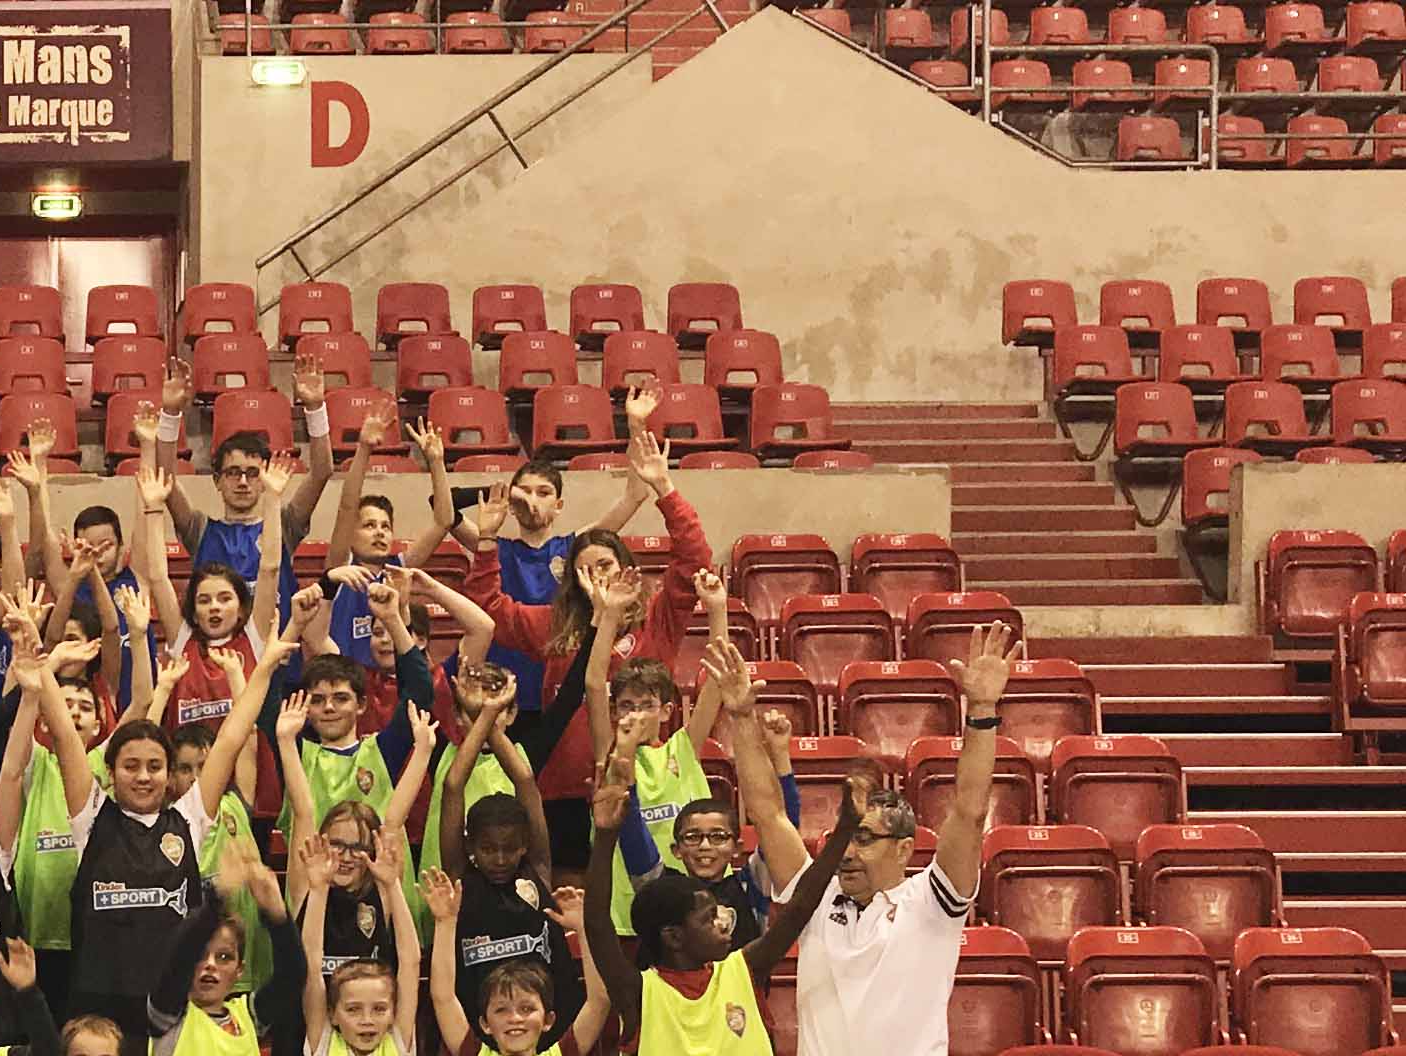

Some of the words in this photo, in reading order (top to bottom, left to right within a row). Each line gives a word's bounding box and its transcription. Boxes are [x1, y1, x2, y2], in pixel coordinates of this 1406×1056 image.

[3, 39, 113, 85] Mans
[8, 95, 114, 146] Marque
[310, 81, 370, 168] D
[640, 806, 670, 821] ORT
[43, 836, 74, 848] SPO
[111, 890, 157, 904] SPORT
[477, 940, 523, 959] SPORT
